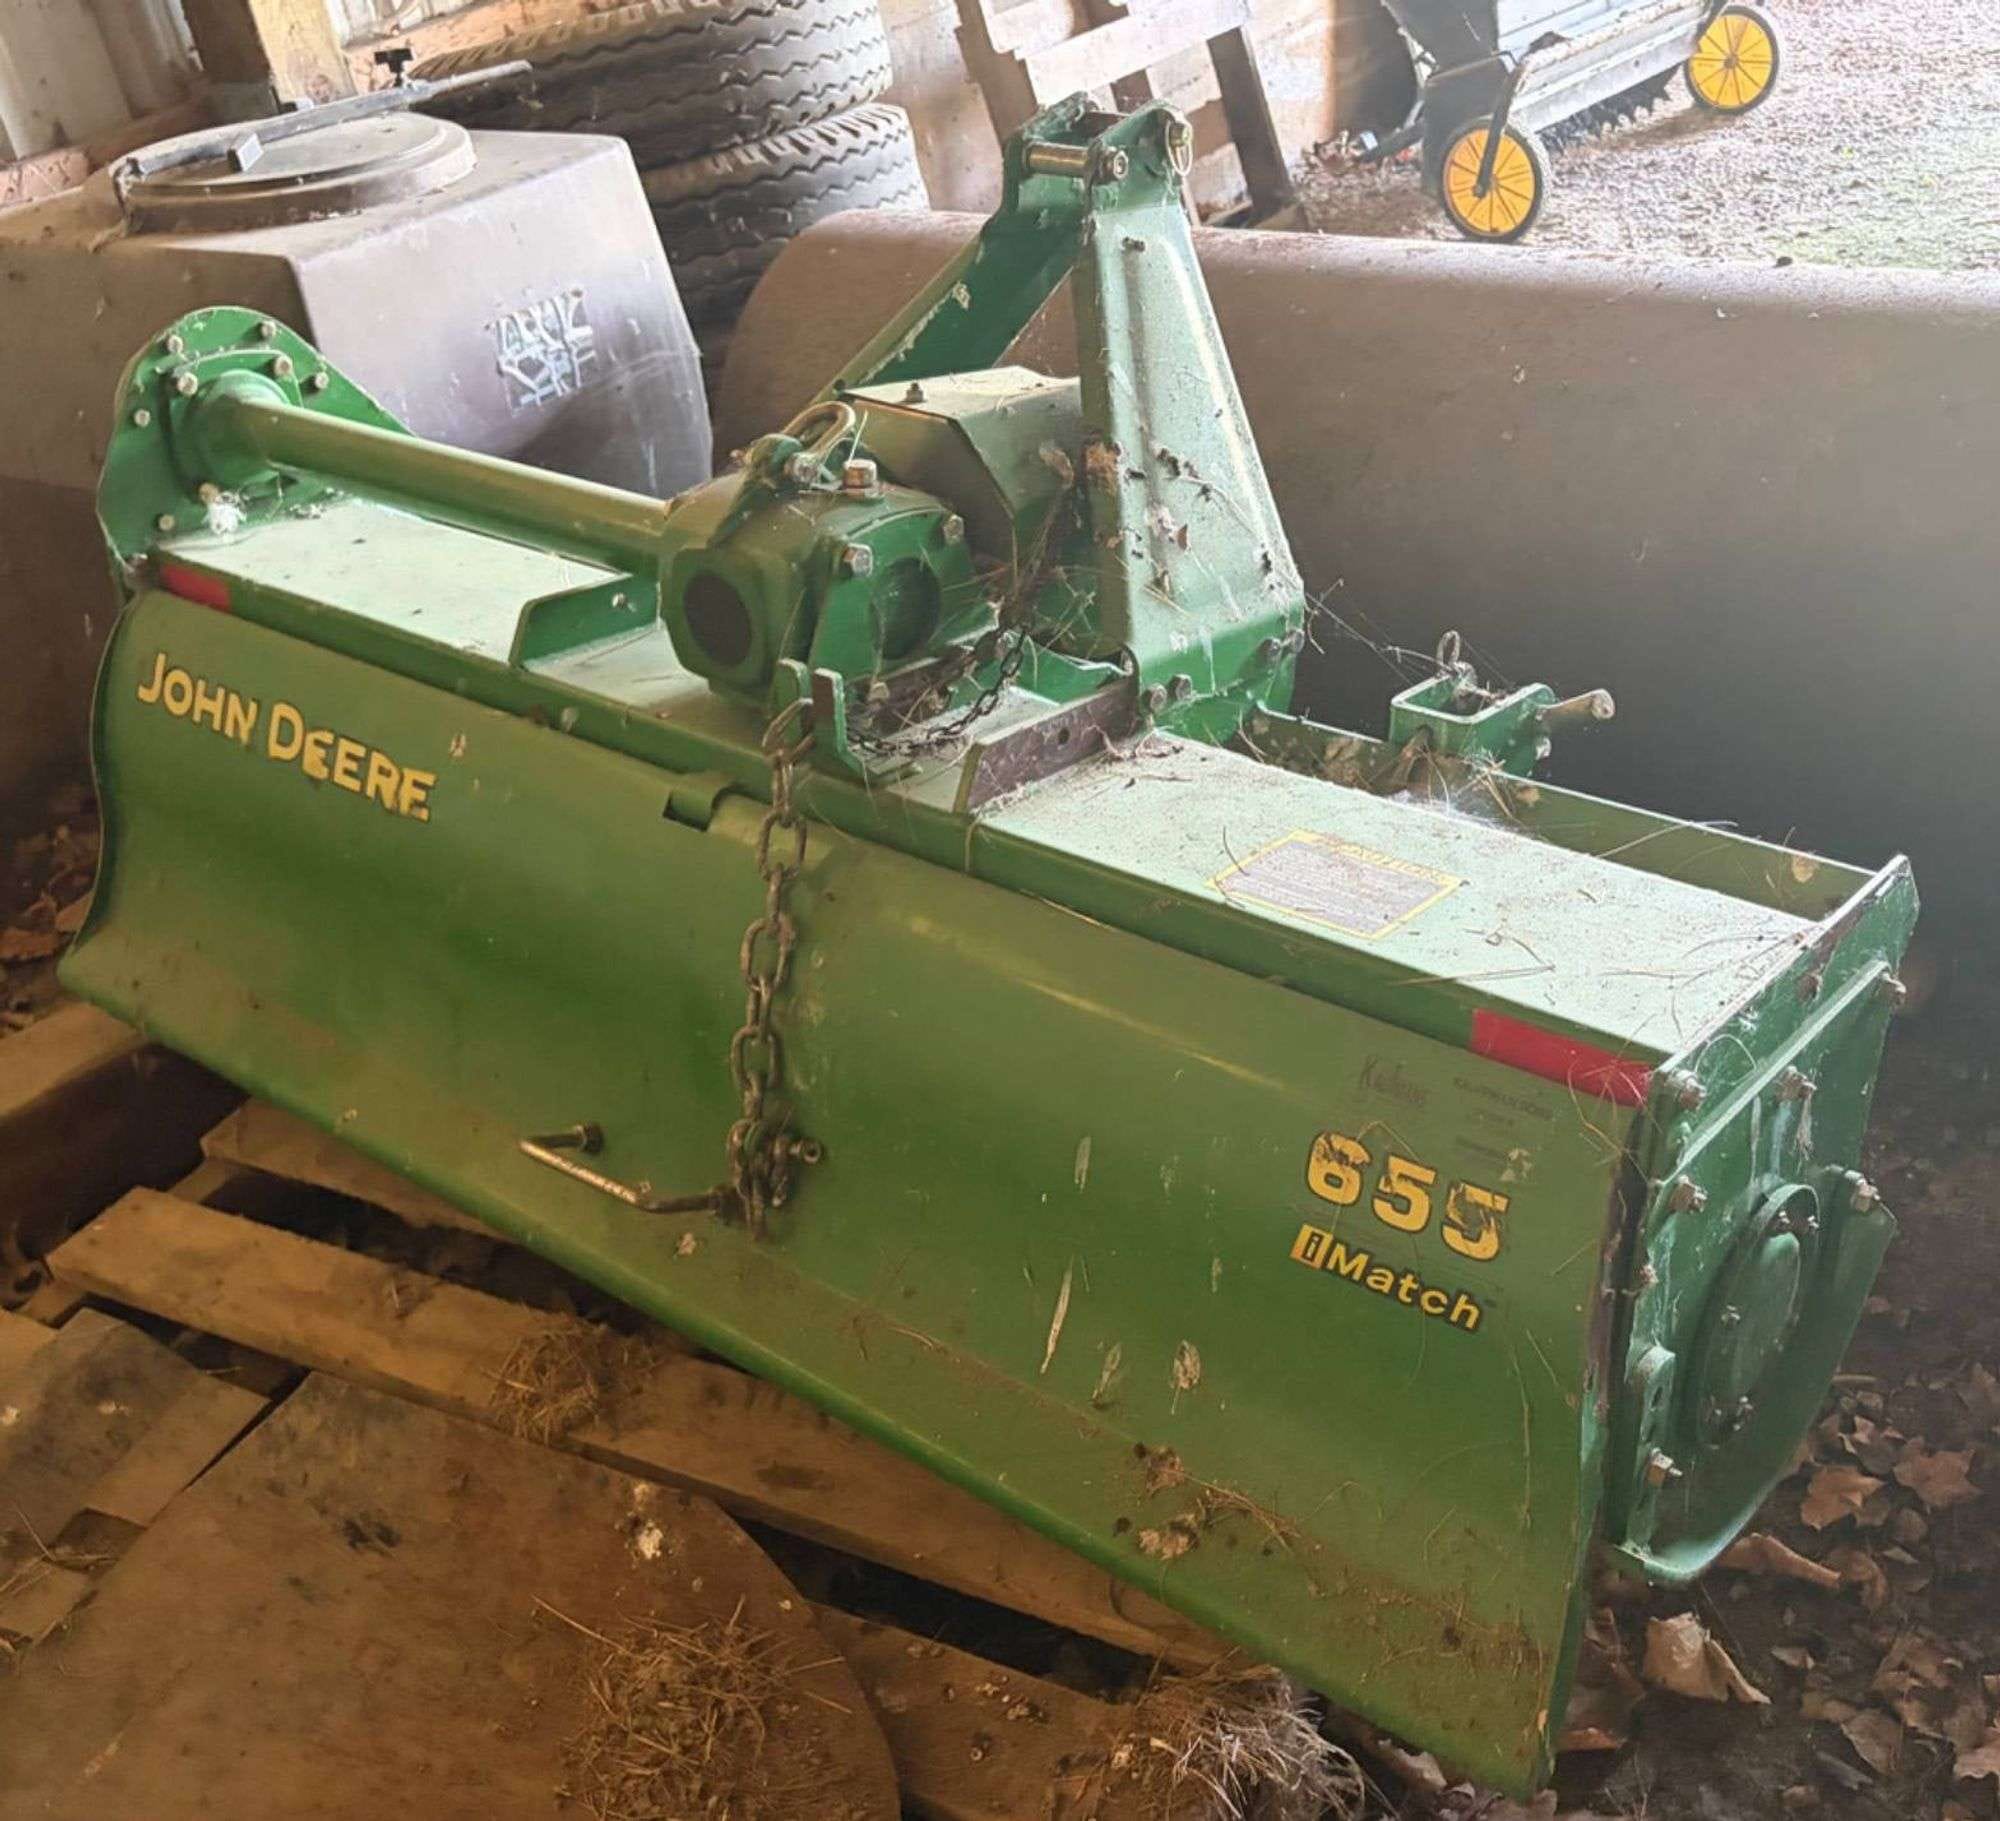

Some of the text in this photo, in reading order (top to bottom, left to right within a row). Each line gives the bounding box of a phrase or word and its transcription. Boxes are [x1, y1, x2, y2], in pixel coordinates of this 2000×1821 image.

[137, 652, 437, 822] JOHN DEERE
[1307, 1131, 1509, 1261] 655
